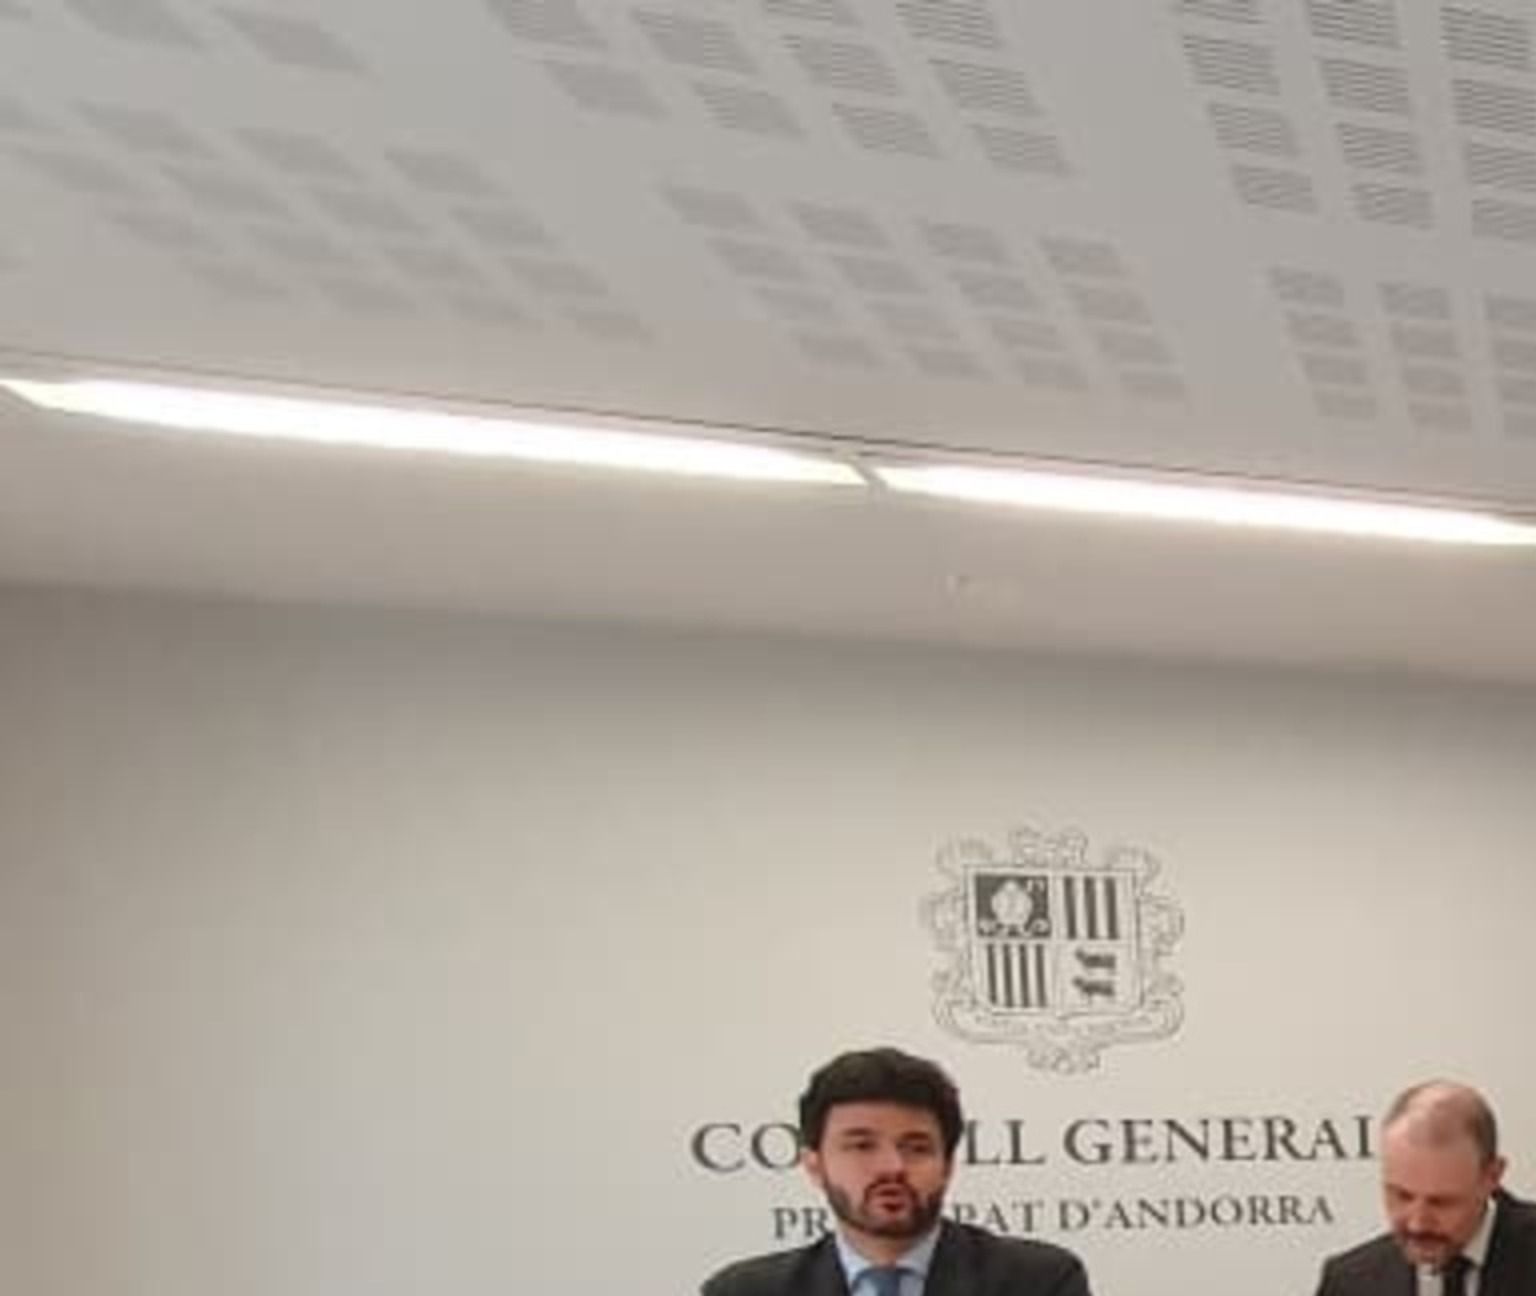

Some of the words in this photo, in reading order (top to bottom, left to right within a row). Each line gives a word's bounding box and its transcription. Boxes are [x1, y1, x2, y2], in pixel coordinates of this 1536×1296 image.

[691, 1118, 1046, 1174] COLL
[772, 1199, 1044, 1240] PRPAT
[1058, 1194, 1335, 1232] D'ANDORRA
